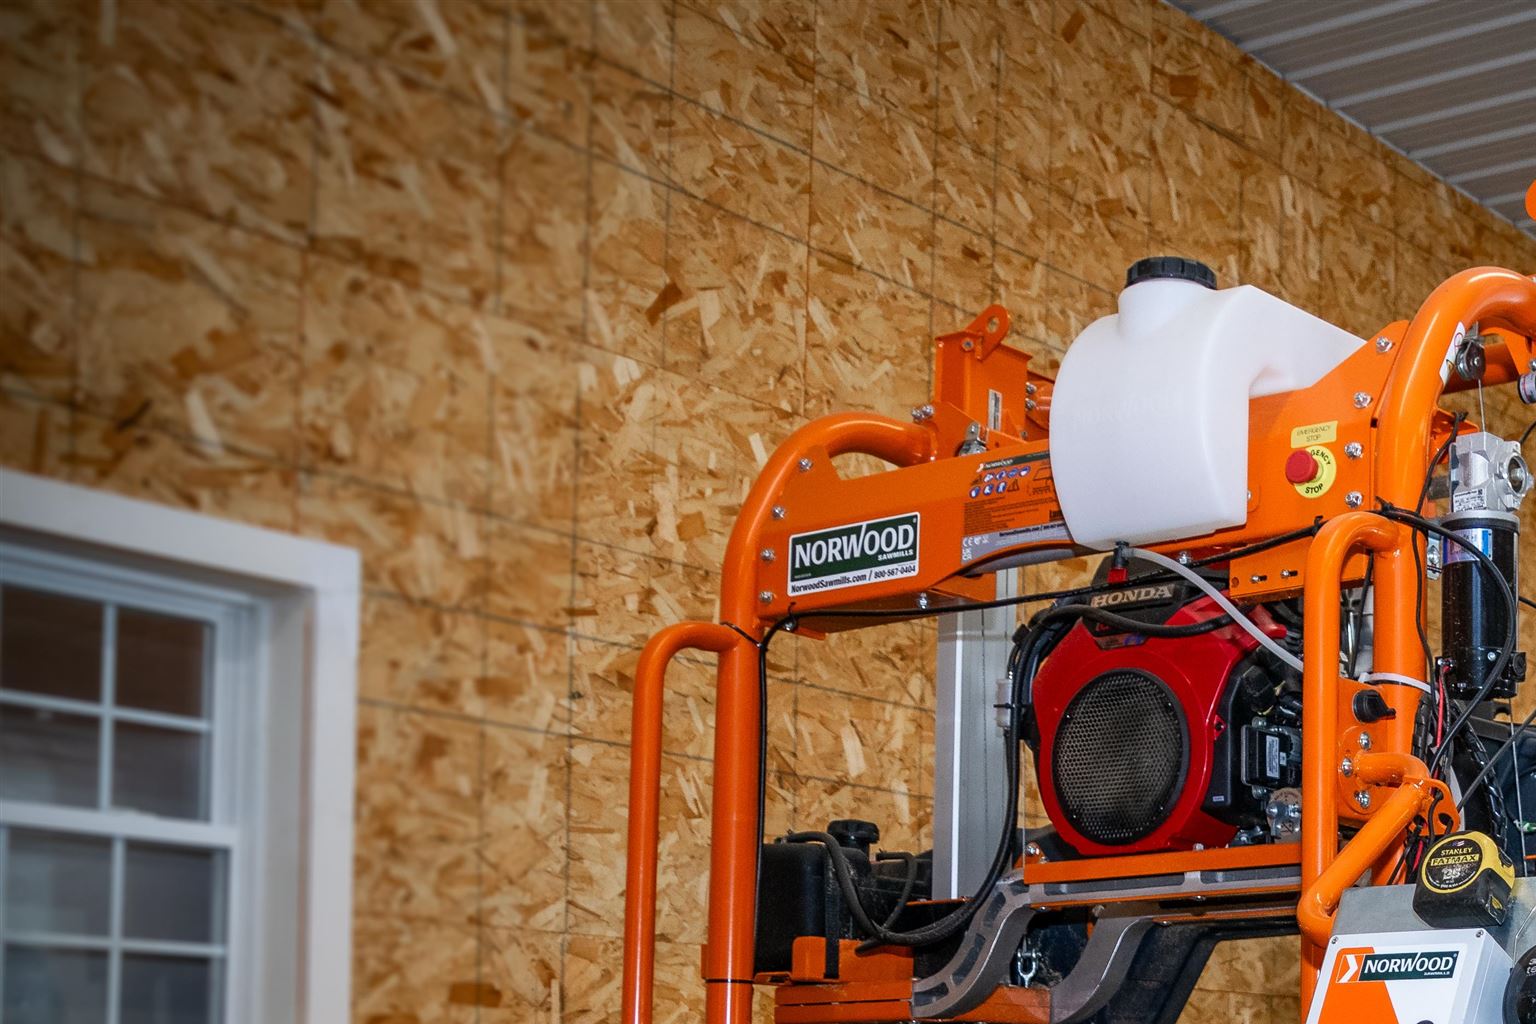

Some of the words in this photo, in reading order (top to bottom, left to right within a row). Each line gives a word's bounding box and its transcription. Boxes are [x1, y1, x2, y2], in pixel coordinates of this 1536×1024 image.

[1297, 425, 1331, 436] EMERGENCY
[1306, 434, 1321, 442] STOP
[1311, 449, 1331, 465] GENCY
[1305, 483, 1323, 494] STOP
[795, 523, 915, 568] NORWOOD
[877, 548, 914, 561] SAWMILLS
[791, 573, 867, 593] NorwoodSawmills.com
[874, 564, 916, 579] 800-567-0404
[1091, 584, 1173, 608] HONDA
[1441, 847, 1473, 856] STANLEY
[1433, 855, 1476, 865] FATMAX
[1364, 952, 1454, 974] NORWOOD
